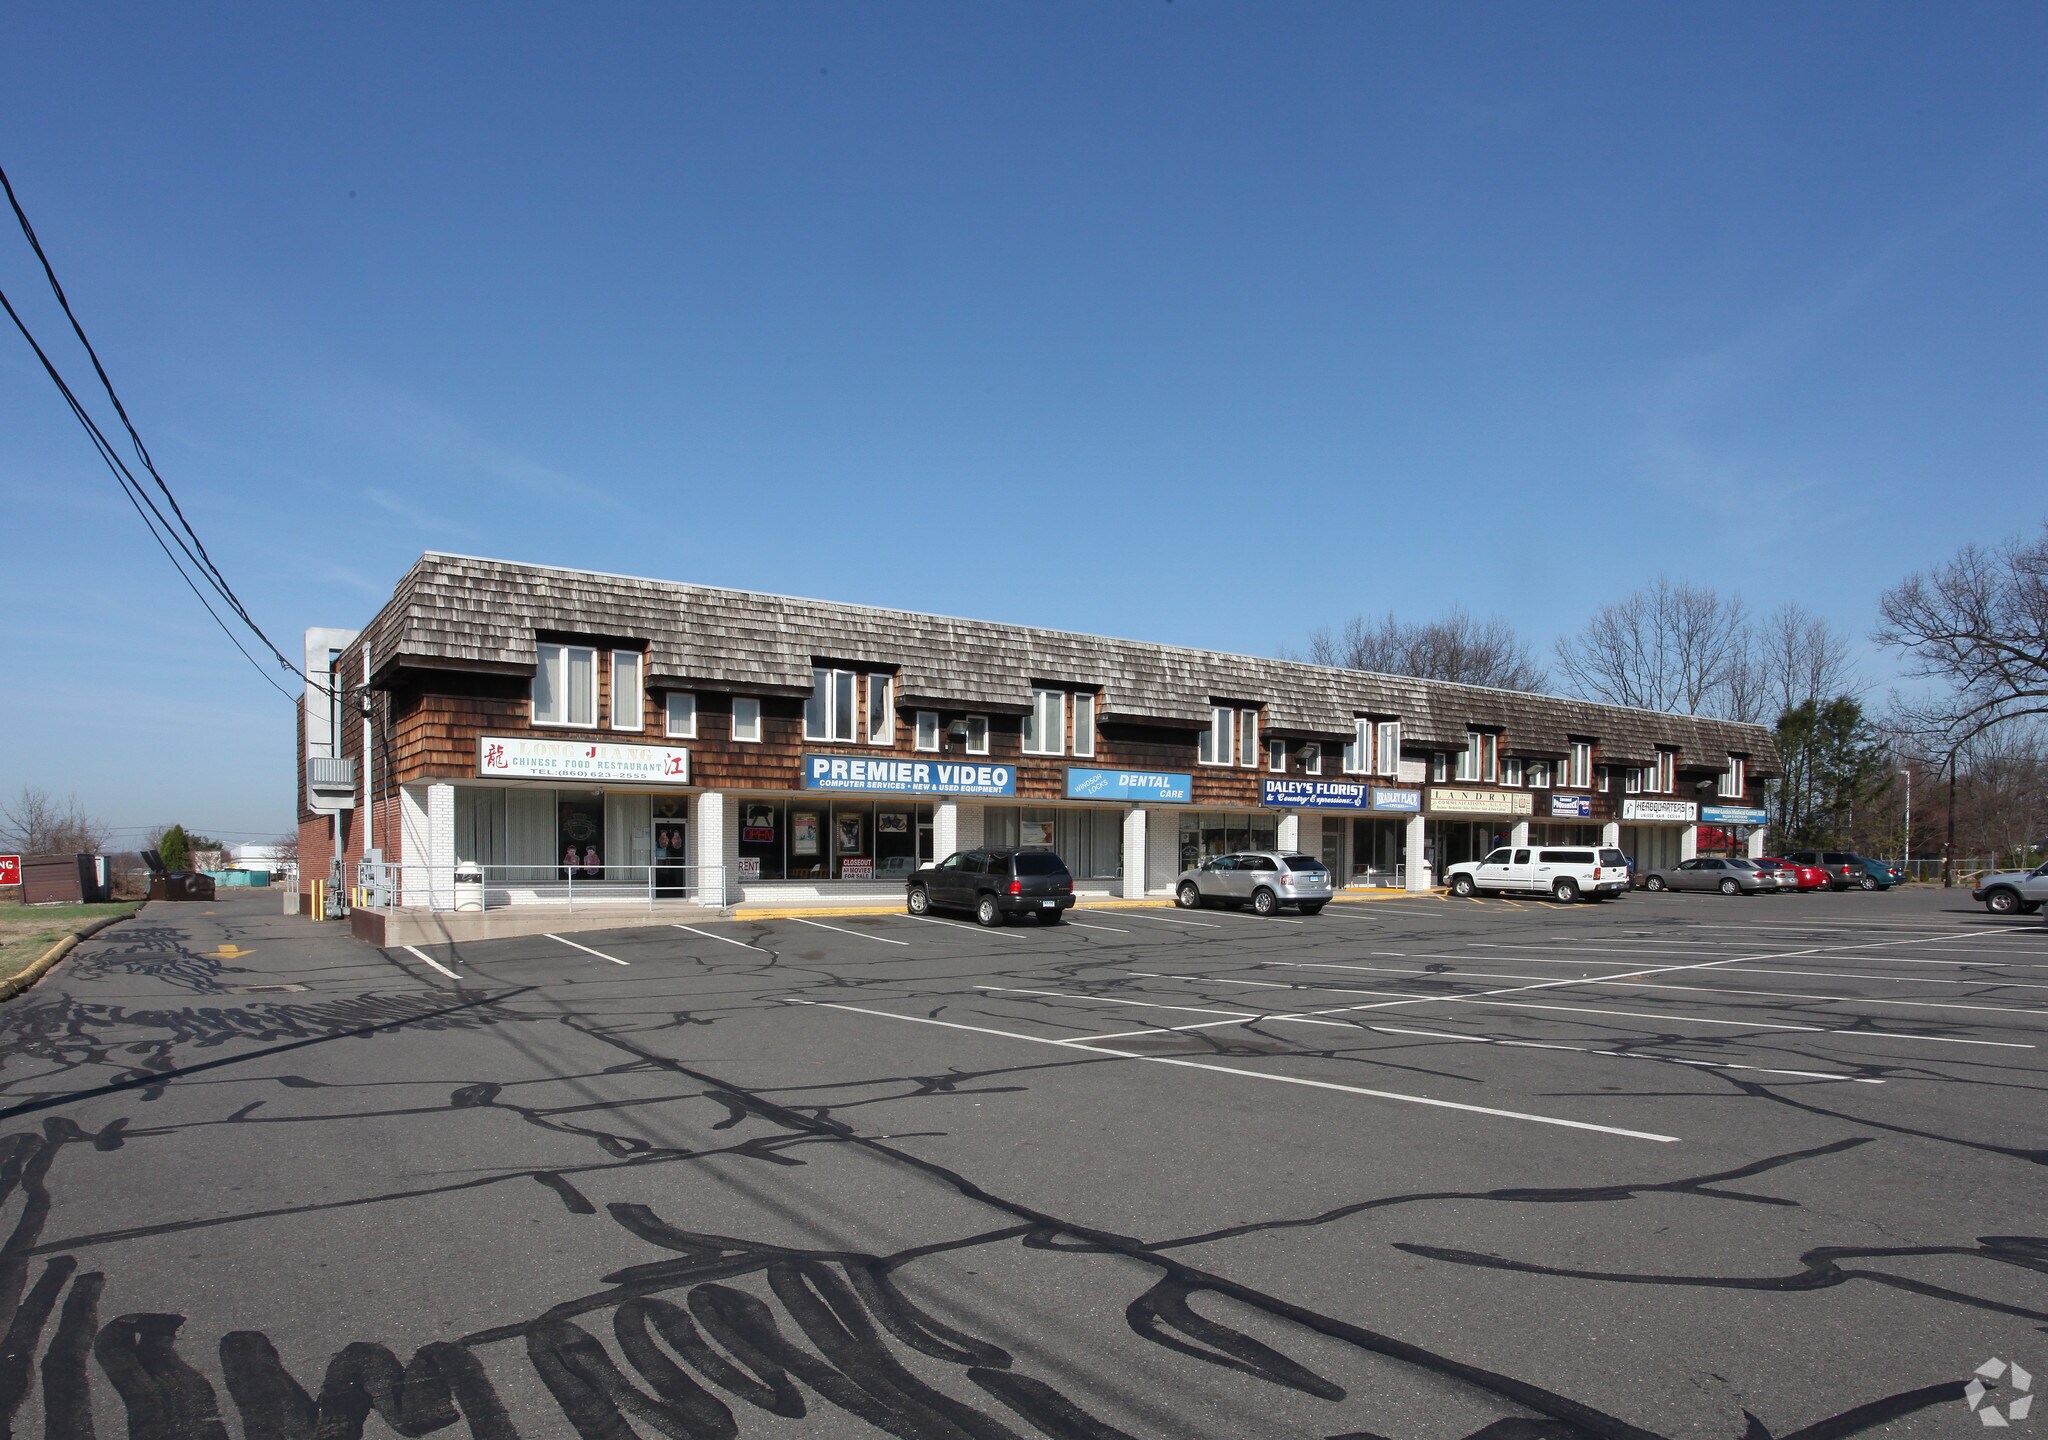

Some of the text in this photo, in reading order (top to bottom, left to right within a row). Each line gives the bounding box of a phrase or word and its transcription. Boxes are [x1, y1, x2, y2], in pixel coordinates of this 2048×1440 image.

[484, 744, 508, 768] 龍
[519, 742, 653, 761] LONG JIANG
[512, 757, 662, 772] CHINESE FOOD RESTAURANT
[664, 752, 684, 776] 江
[814, 758, 1008, 786] PREMIER VIDEO
[820, 779, 865, 788] COMPUTER
[867, 781, 906, 790] SERVICES
[960, 785, 1003, 793] EQUIPMENT
[1074, 773, 1102, 793] WINDSOR
[1088, 779, 1108, 794] LOCKS
[1119, 774, 1170, 788] DENTAL
[1266, 780, 1365, 796] DALEY'S FLORIST
[1160, 790, 1183, 798] CARE
[1277, 793, 1309, 804] Country
[1376, 792, 1417, 806] BRADLEY PLACE
[1435, 791, 1508, 801] LANDRY
[744, 829, 772, 840] OPEN
[739, 861, 759, 870] RENT
